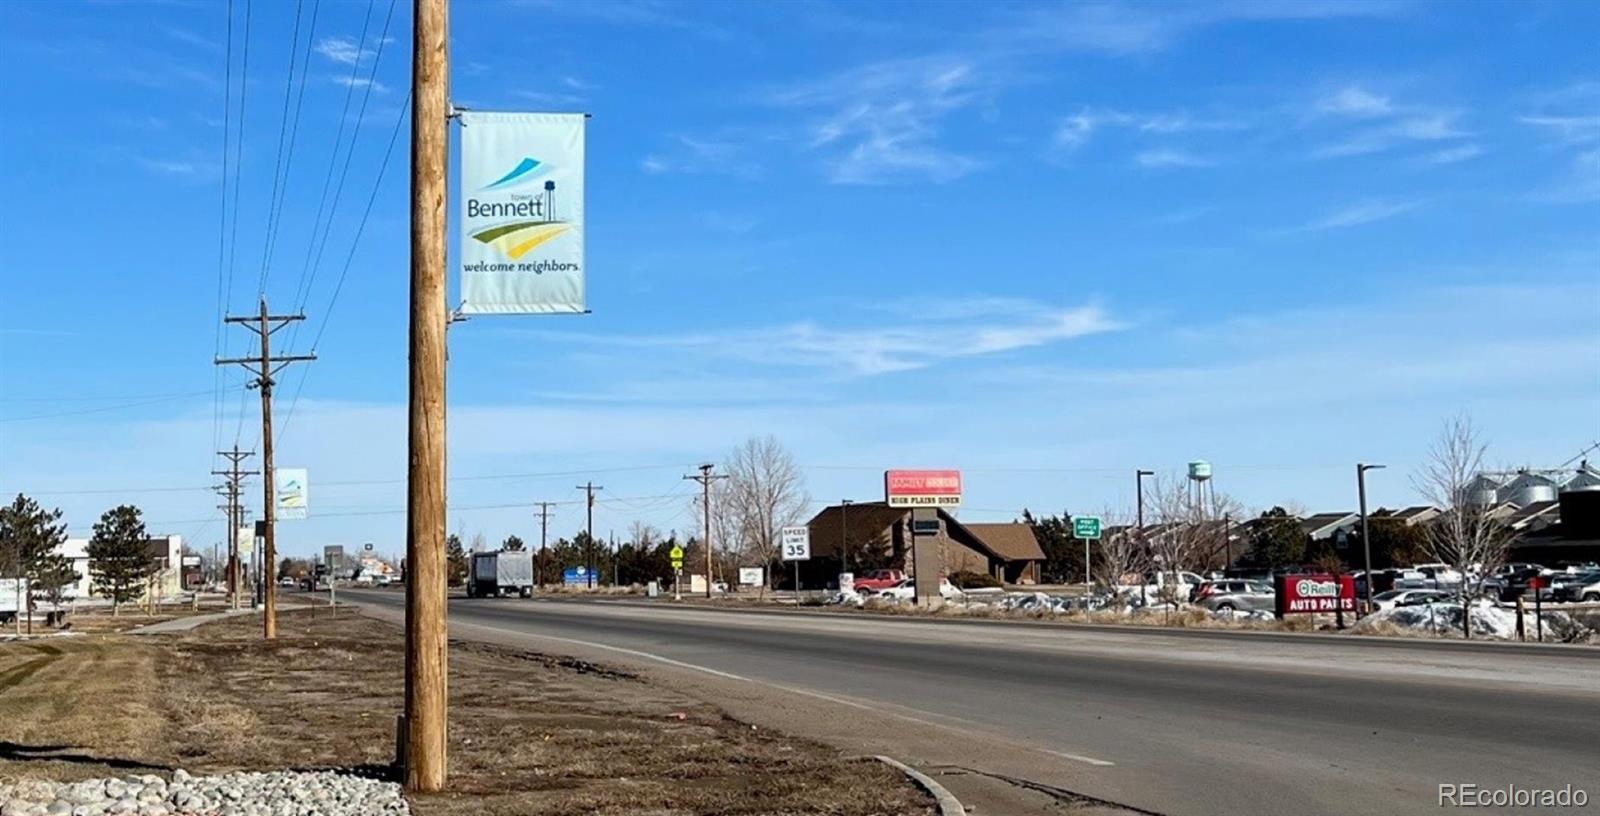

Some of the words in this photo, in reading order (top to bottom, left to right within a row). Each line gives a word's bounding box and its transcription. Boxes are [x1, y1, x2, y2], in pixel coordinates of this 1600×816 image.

[468, 199, 543, 217] Bennett
[463, 261, 515, 272] welcome
[787, 545, 805, 556] 35
[1290, 600, 1317, 611] AUTO
